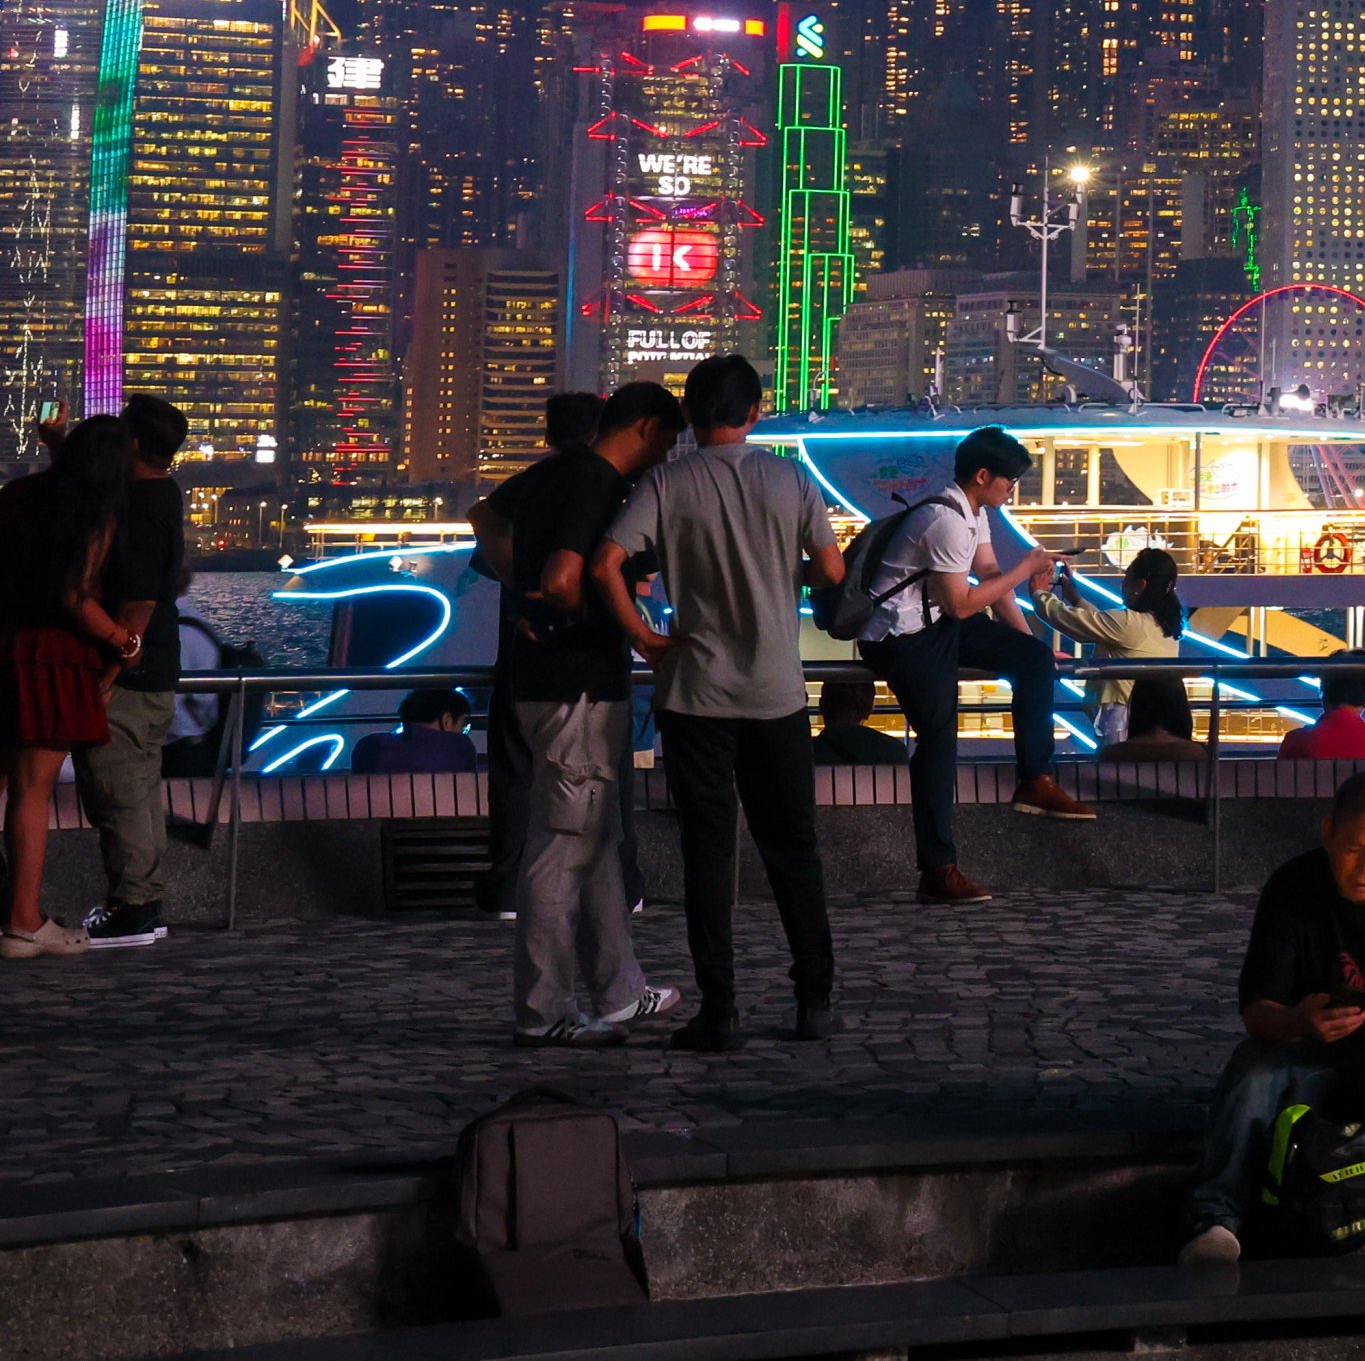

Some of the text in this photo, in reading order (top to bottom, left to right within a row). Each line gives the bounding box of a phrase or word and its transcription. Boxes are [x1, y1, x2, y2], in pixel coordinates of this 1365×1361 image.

[638, 154, 712, 175] WE'RE
[627, 330, 711, 349] FULL OF
